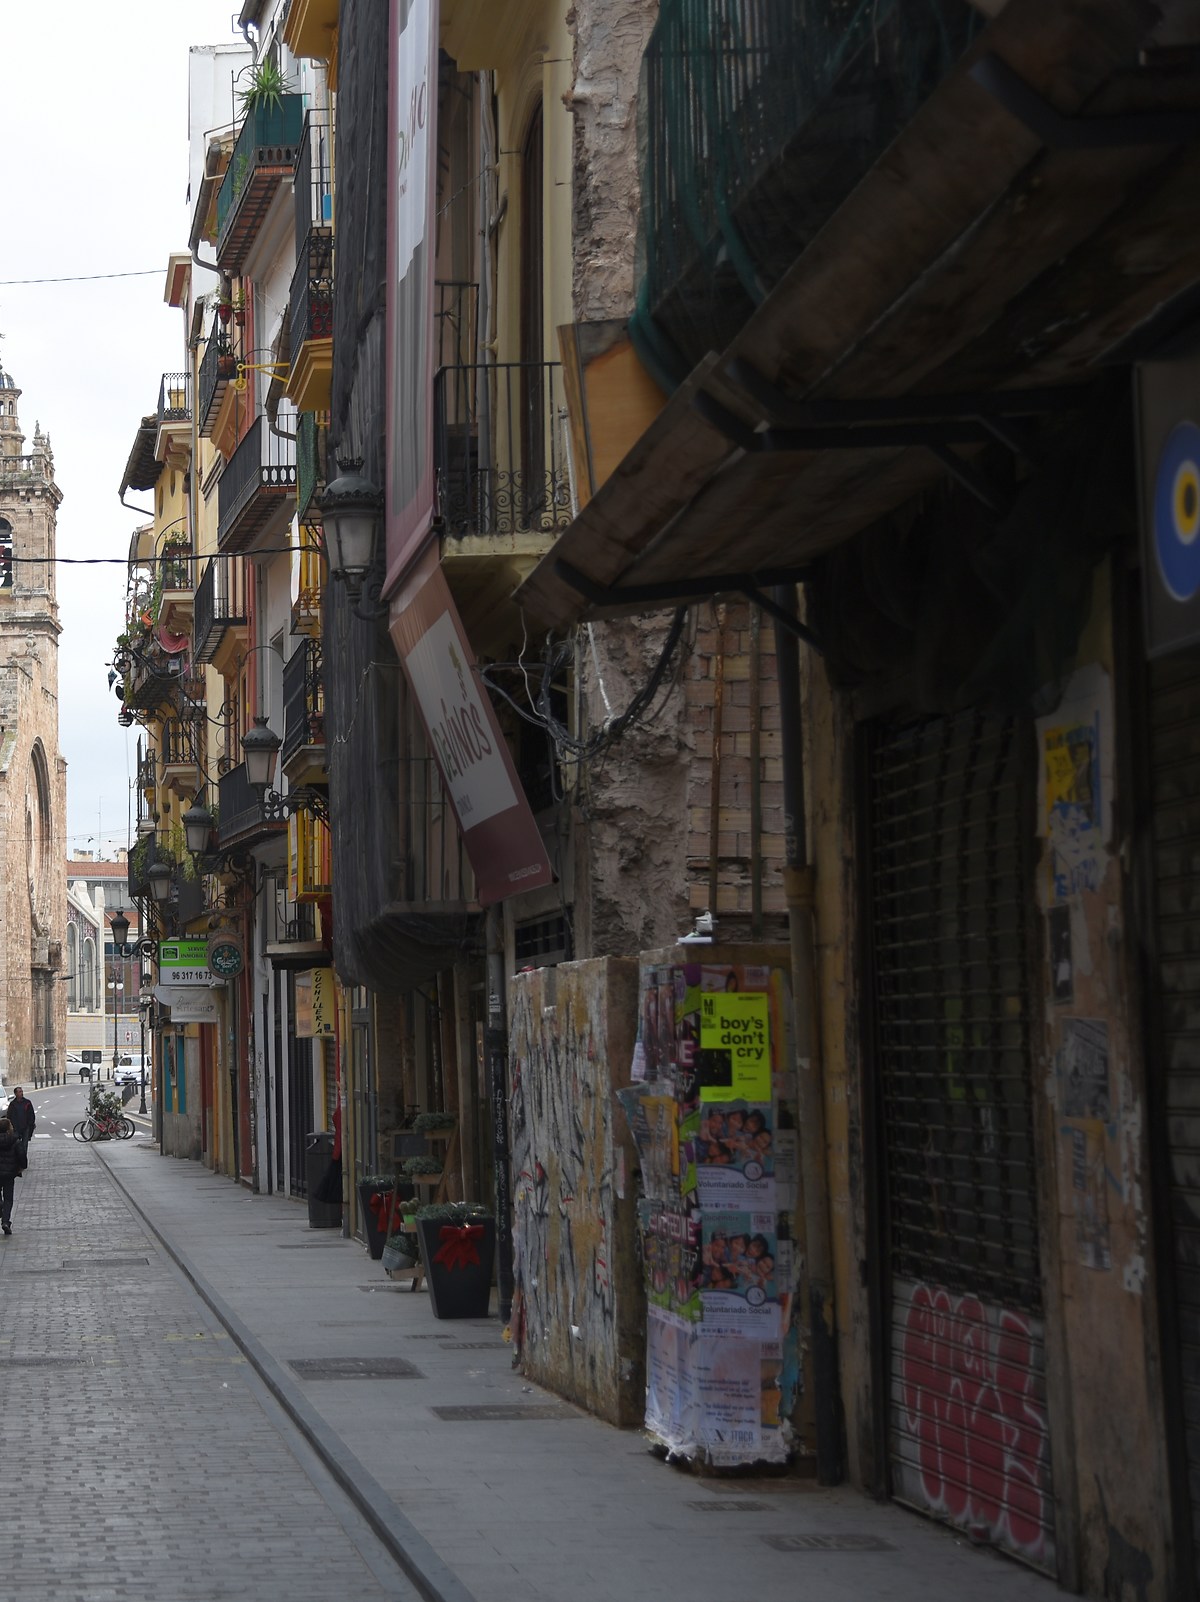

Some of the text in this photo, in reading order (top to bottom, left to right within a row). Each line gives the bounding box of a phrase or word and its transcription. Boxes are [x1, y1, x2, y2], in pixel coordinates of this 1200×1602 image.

[172, 972, 213, 980] 96 317 16 73
[312, 969, 324, 1034] CUCHILLERIA
[720, 1015, 764, 1031] boy's
[720, 1032, 764, 1045] don't
[736, 1047, 764, 1060] cry
[747, 1180, 769, 1189] Social
[749, 1306, 772, 1314] Social
